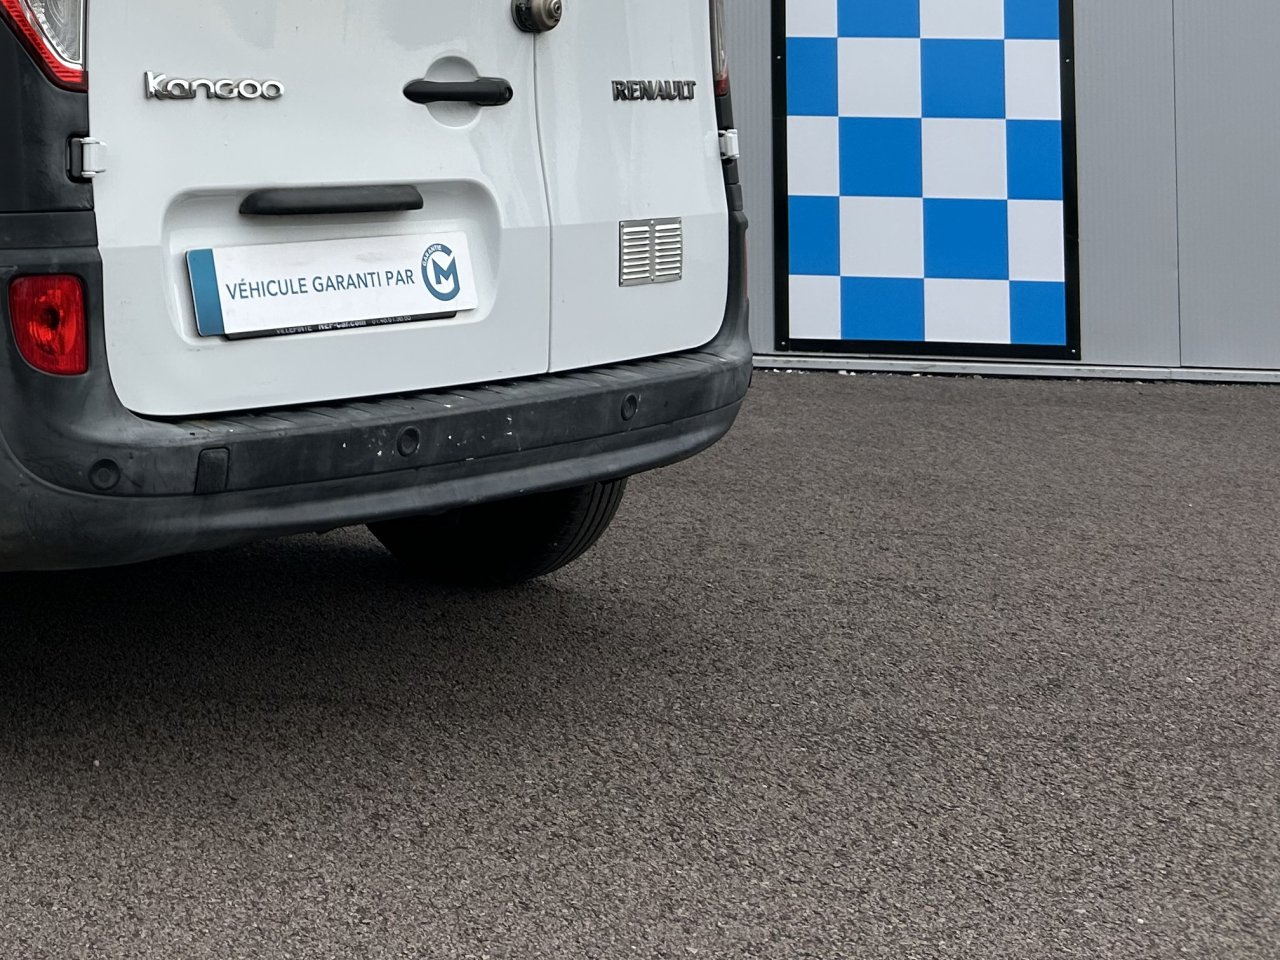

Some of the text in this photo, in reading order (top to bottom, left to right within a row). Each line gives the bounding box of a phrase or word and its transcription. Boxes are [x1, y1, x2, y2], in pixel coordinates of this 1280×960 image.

[611, 80, 696, 101] RENAULT
[225, 277, 309, 300] VÉHICULE
[312, 271, 382, 293] GARANTI
[385, 269, 415, 286] PAR
